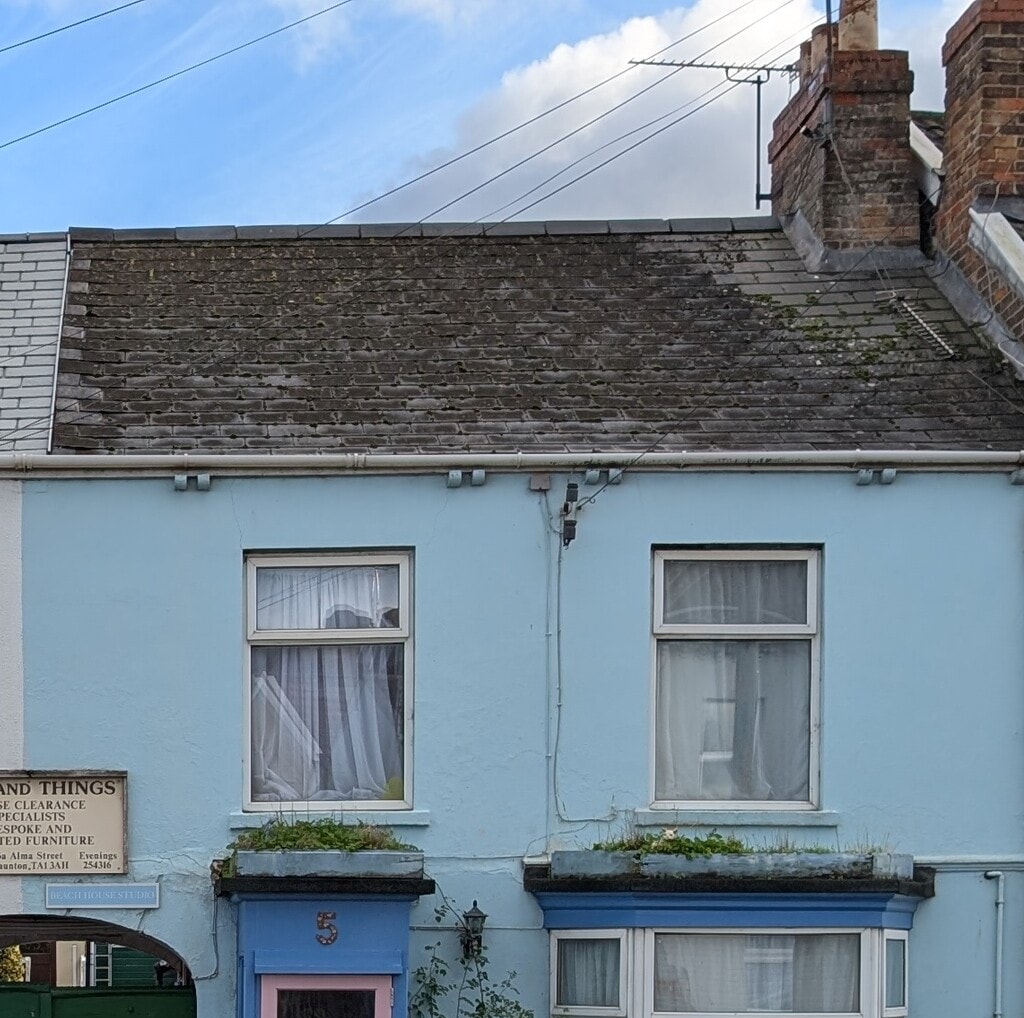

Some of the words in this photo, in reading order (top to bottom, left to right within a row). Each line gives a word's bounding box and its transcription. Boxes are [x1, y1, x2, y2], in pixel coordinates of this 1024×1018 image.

[39, 780, 116, 796] THINGS
[14, 800, 86, 810] CLEARANCE
[45, 824, 72, 834] AND
[25, 836, 95, 846] FURNITURE
[9, 852, 33, 860] Alma
[36, 852, 63, 860] Street
[79, 851, 118, 860] Evenings
[83, 861, 112, 870] 254316
[50, 890, 81, 900] BEACH
[83, 890, 117, 900] HOUSE
[118, 890, 155, 900] STUDIO
[315, 911, 339, 946] 5
